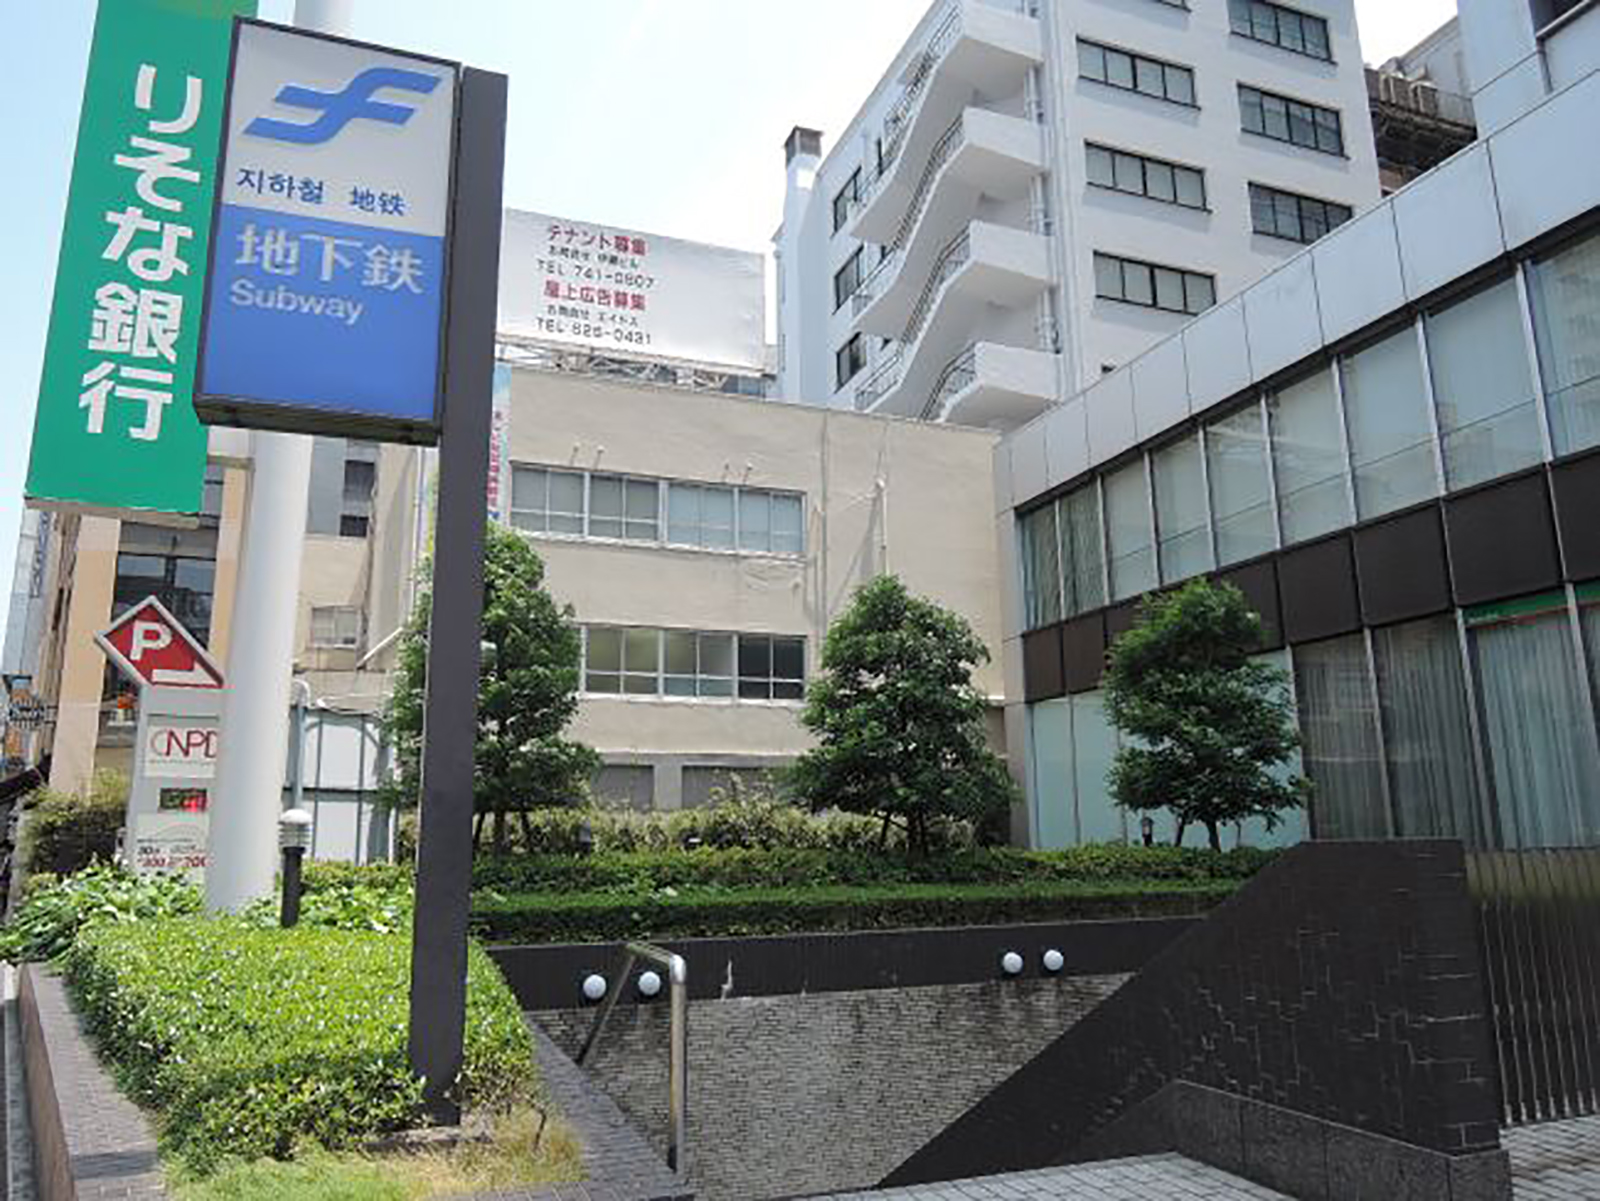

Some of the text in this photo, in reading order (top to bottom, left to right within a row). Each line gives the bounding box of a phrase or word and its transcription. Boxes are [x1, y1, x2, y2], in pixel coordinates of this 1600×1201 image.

[236, 168, 324, 205] 지하철
[79, 63, 202, 441] りそな銀行
[235, 222, 425, 294] 地下鉄
[549, 226, 646, 255] テナント募集
[536, 258, 566, 276] TEL
[230, 279, 363, 326] Subway
[545, 280, 645, 310] 屋上広告募集
[536, 316, 565, 334] TEL
[130, 621, 172, 661] P
